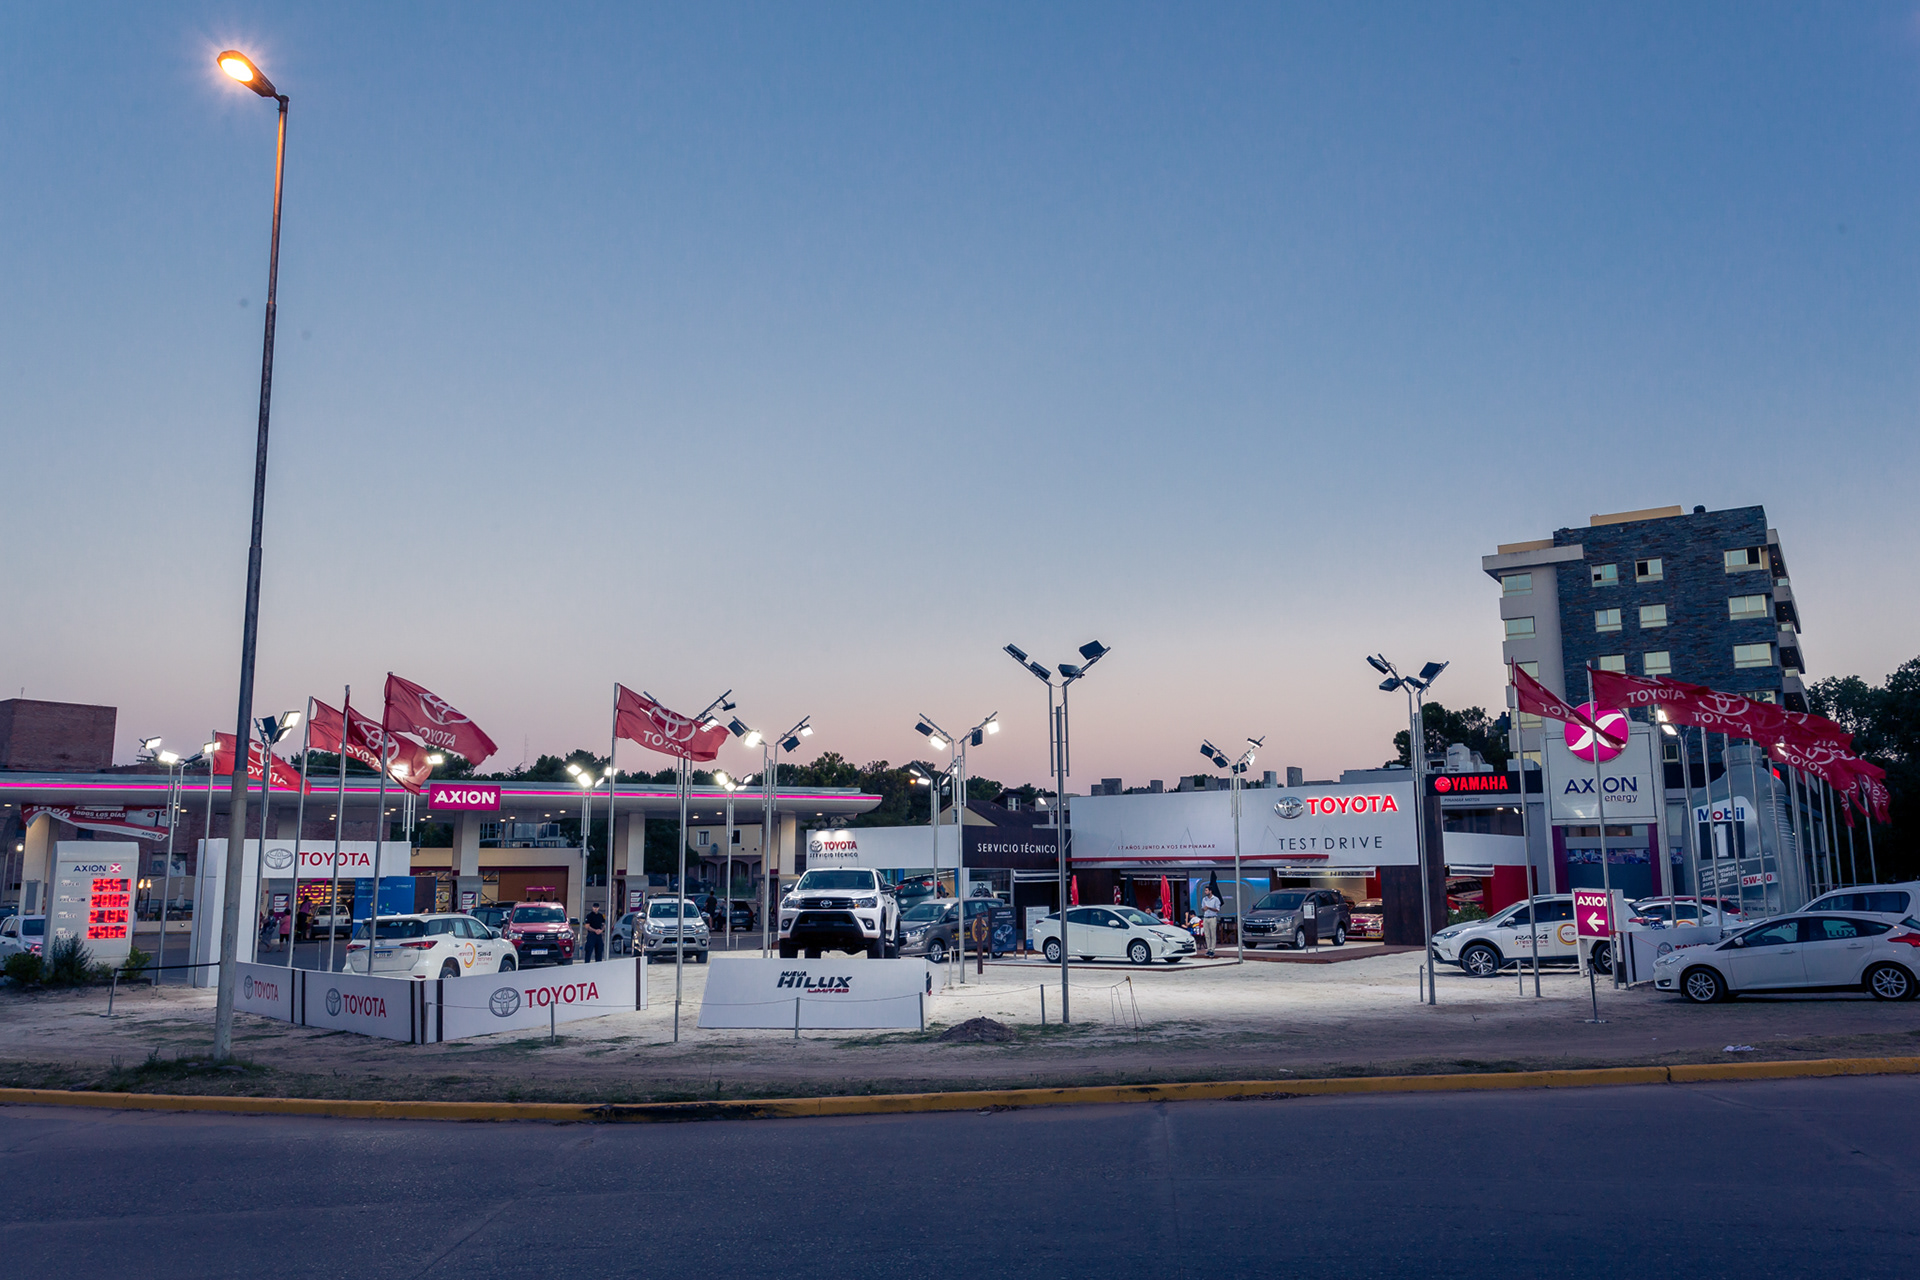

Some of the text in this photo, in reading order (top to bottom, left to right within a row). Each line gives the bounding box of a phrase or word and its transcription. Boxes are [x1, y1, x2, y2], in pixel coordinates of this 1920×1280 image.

[1627, 689, 1686, 704] TOYOTA
[1451, 775, 1508, 791] YAMAHA
[1564, 776, 1638, 794] AXON
[434, 790, 496, 805] AXION
[1306, 795, 1399, 815] TOYOTA
[1604, 794, 1638, 803] energy
[824, 841, 857, 850] TOYOTA
[977, 843, 1056, 853] SERVICIO TÉCNICO
[1279, 836, 1382, 850] TEST DRIVE
[299, 852, 370, 866] TOYOTA
[1743, 874, 1773, 885] 5W-0
[777, 976, 853, 988] HILUX
[254, 980, 279, 1001] TOYOTA
[525, 982, 599, 1008] TOYOTA
[343, 994, 387, 1018] TOYOTA
